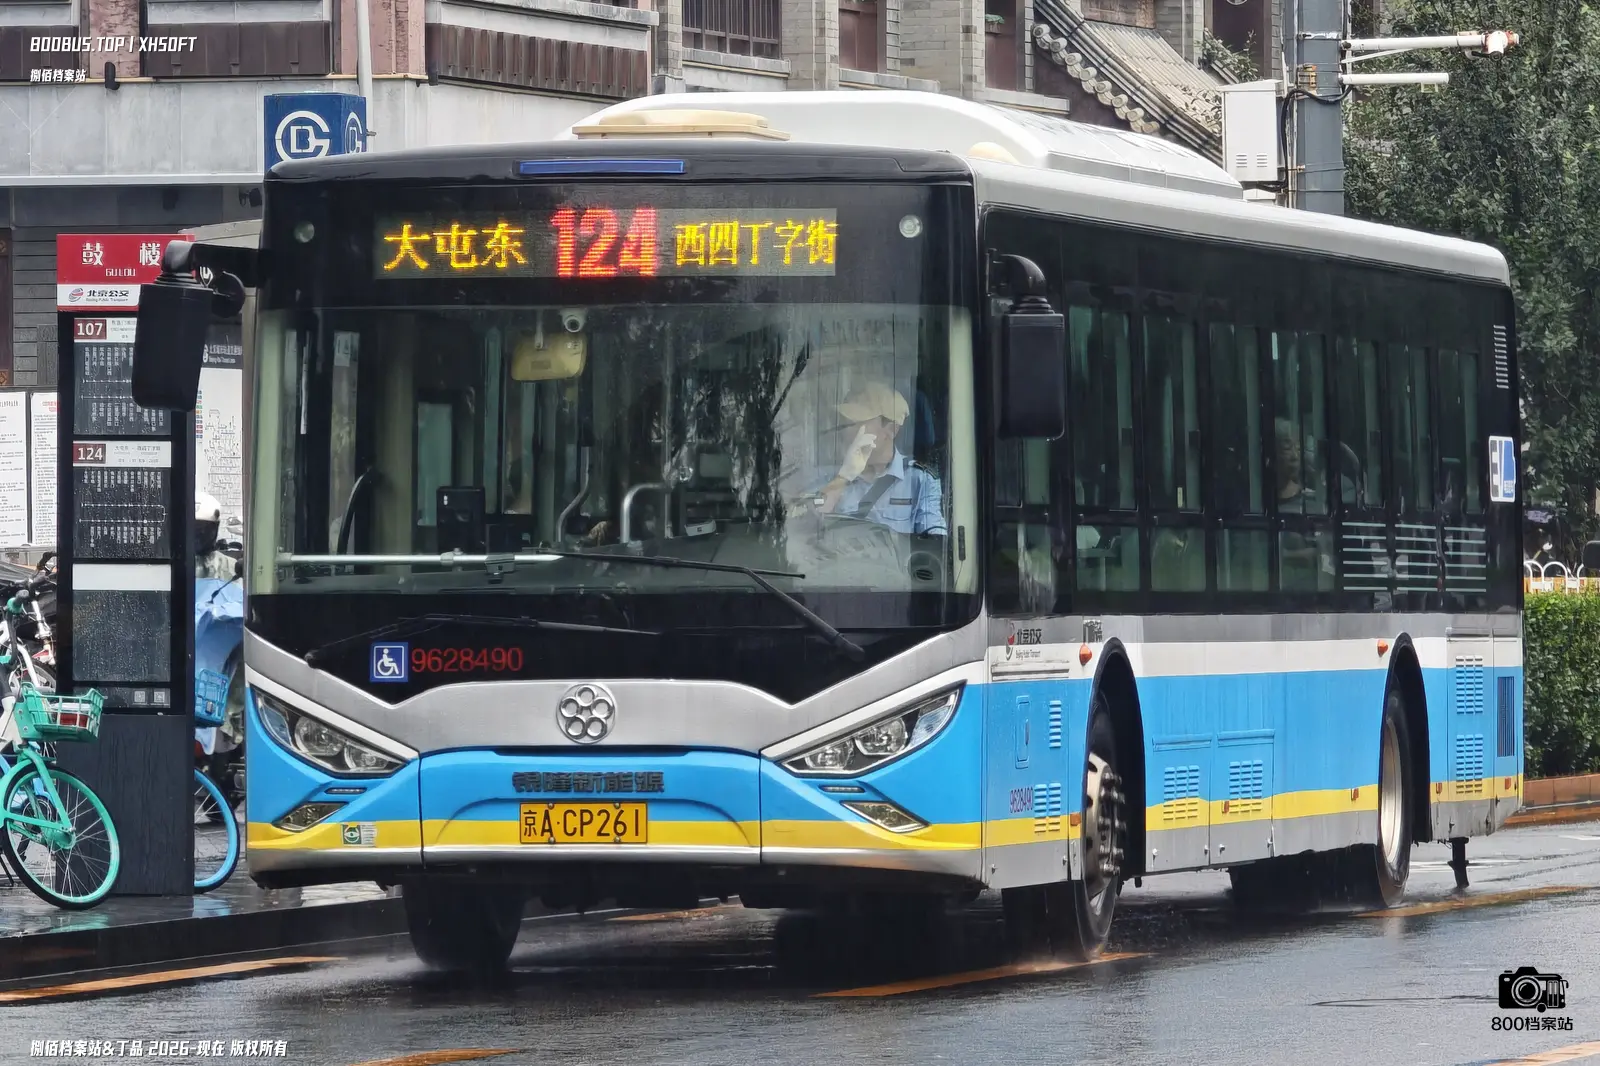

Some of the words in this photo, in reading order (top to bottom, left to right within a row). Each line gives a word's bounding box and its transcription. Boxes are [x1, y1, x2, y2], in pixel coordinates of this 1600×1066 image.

[383, 221, 529, 270] 大屯东
[549, 202, 659, 278] 124
[674, 218, 838, 267] 西四丁字街
[87, 289, 130, 298] 北京公交
[77, 322, 103, 336] 107
[78, 447, 103, 461] 124
[410, 648, 523, 673] 9628490
